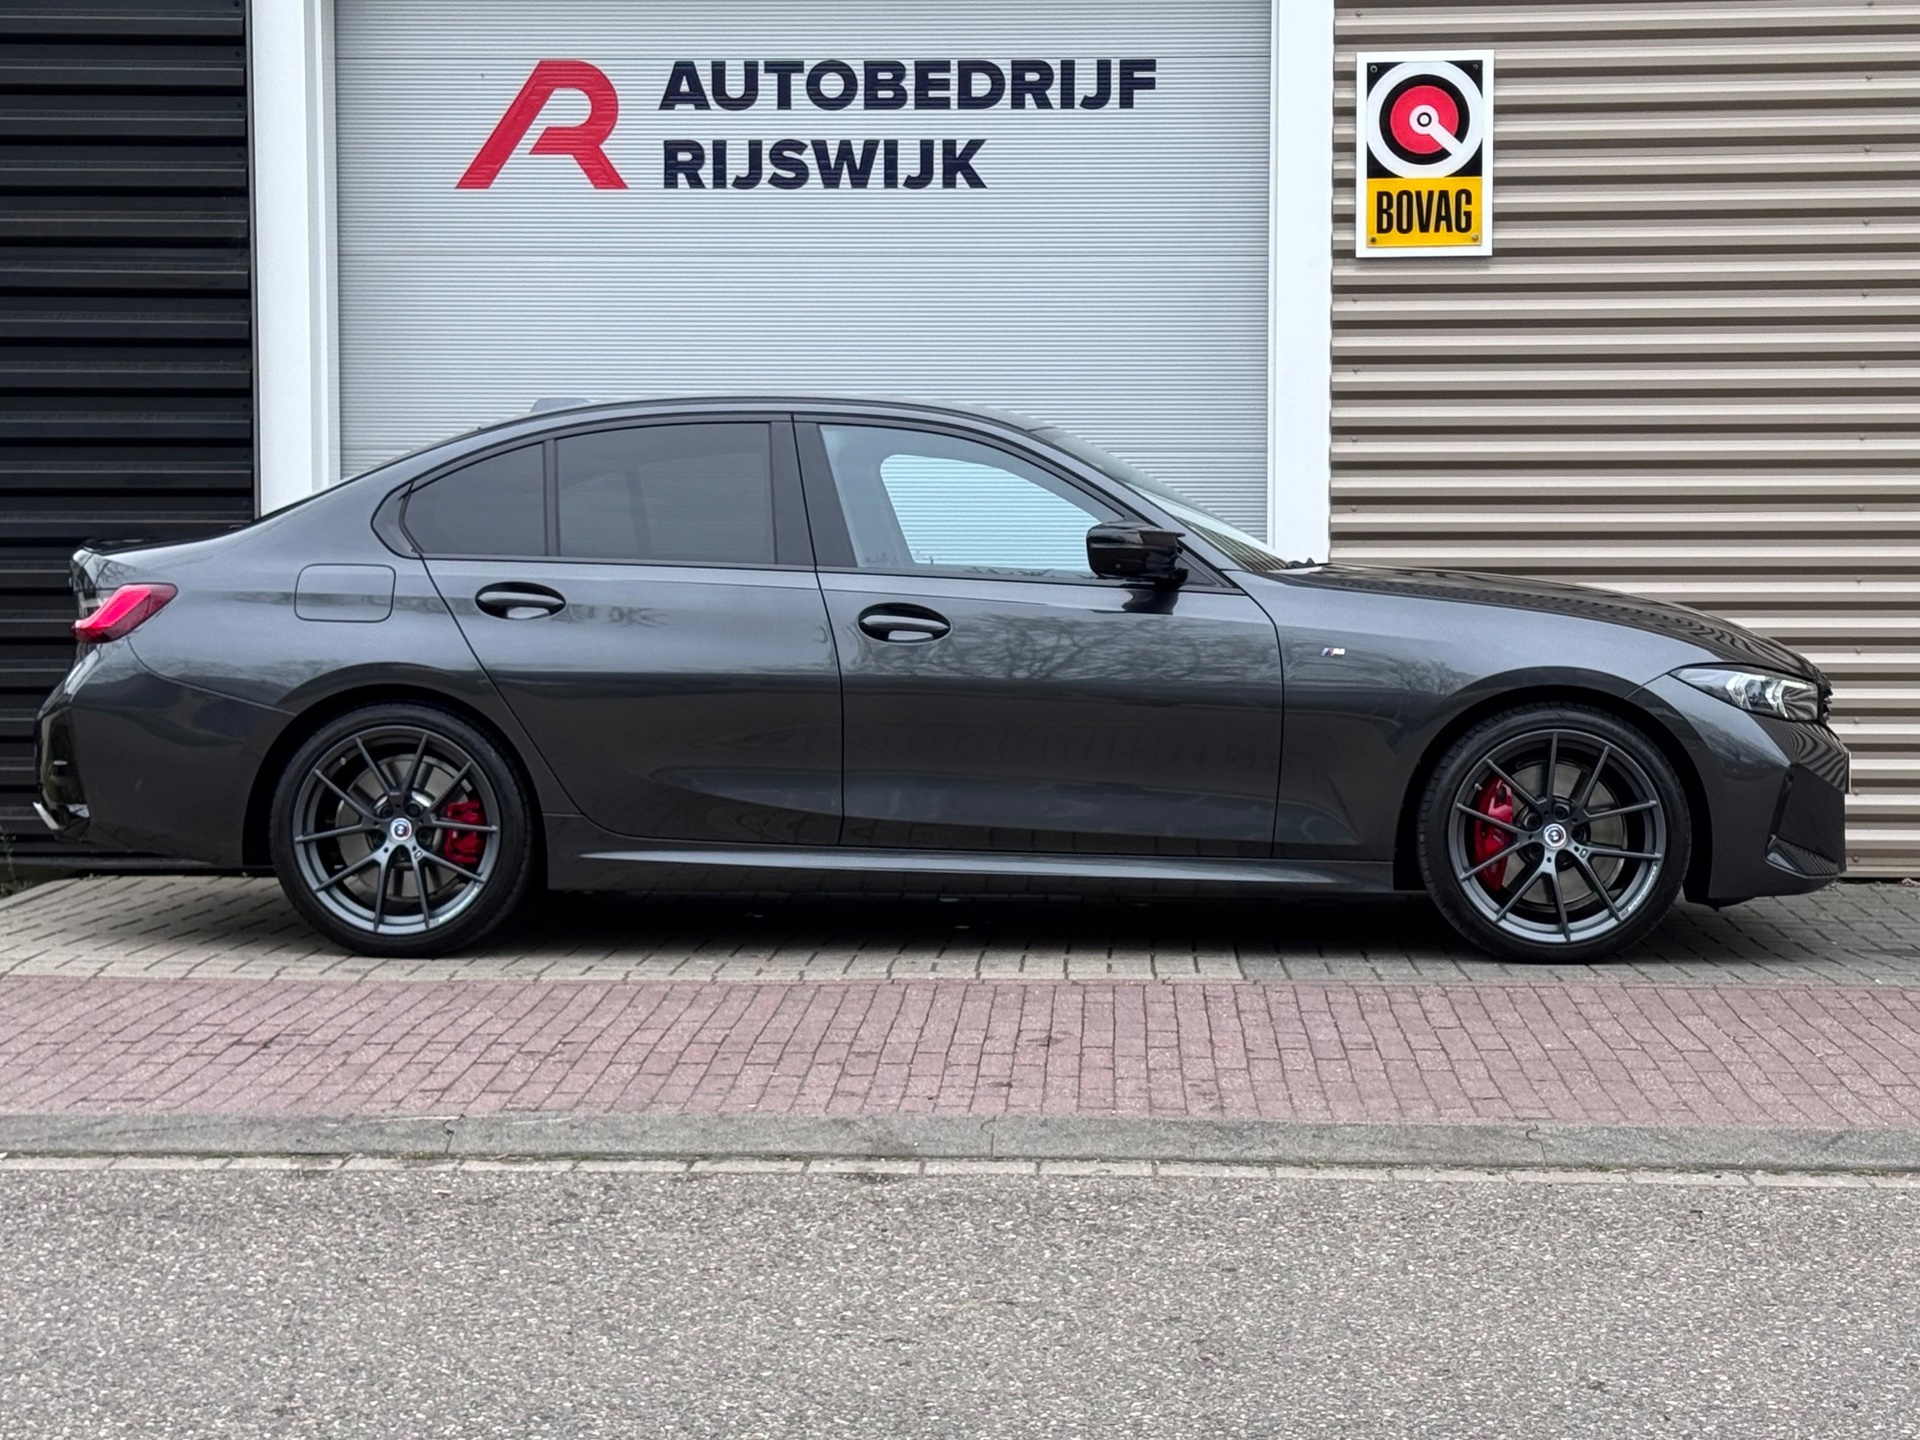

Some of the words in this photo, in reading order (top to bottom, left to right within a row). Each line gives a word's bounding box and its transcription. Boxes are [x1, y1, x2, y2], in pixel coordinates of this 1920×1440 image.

[658, 58, 1158, 111] AUTOBEDRIJF
[663, 138, 988, 190] RIJSWIJK
[1376, 188, 1473, 234] BOVAG
